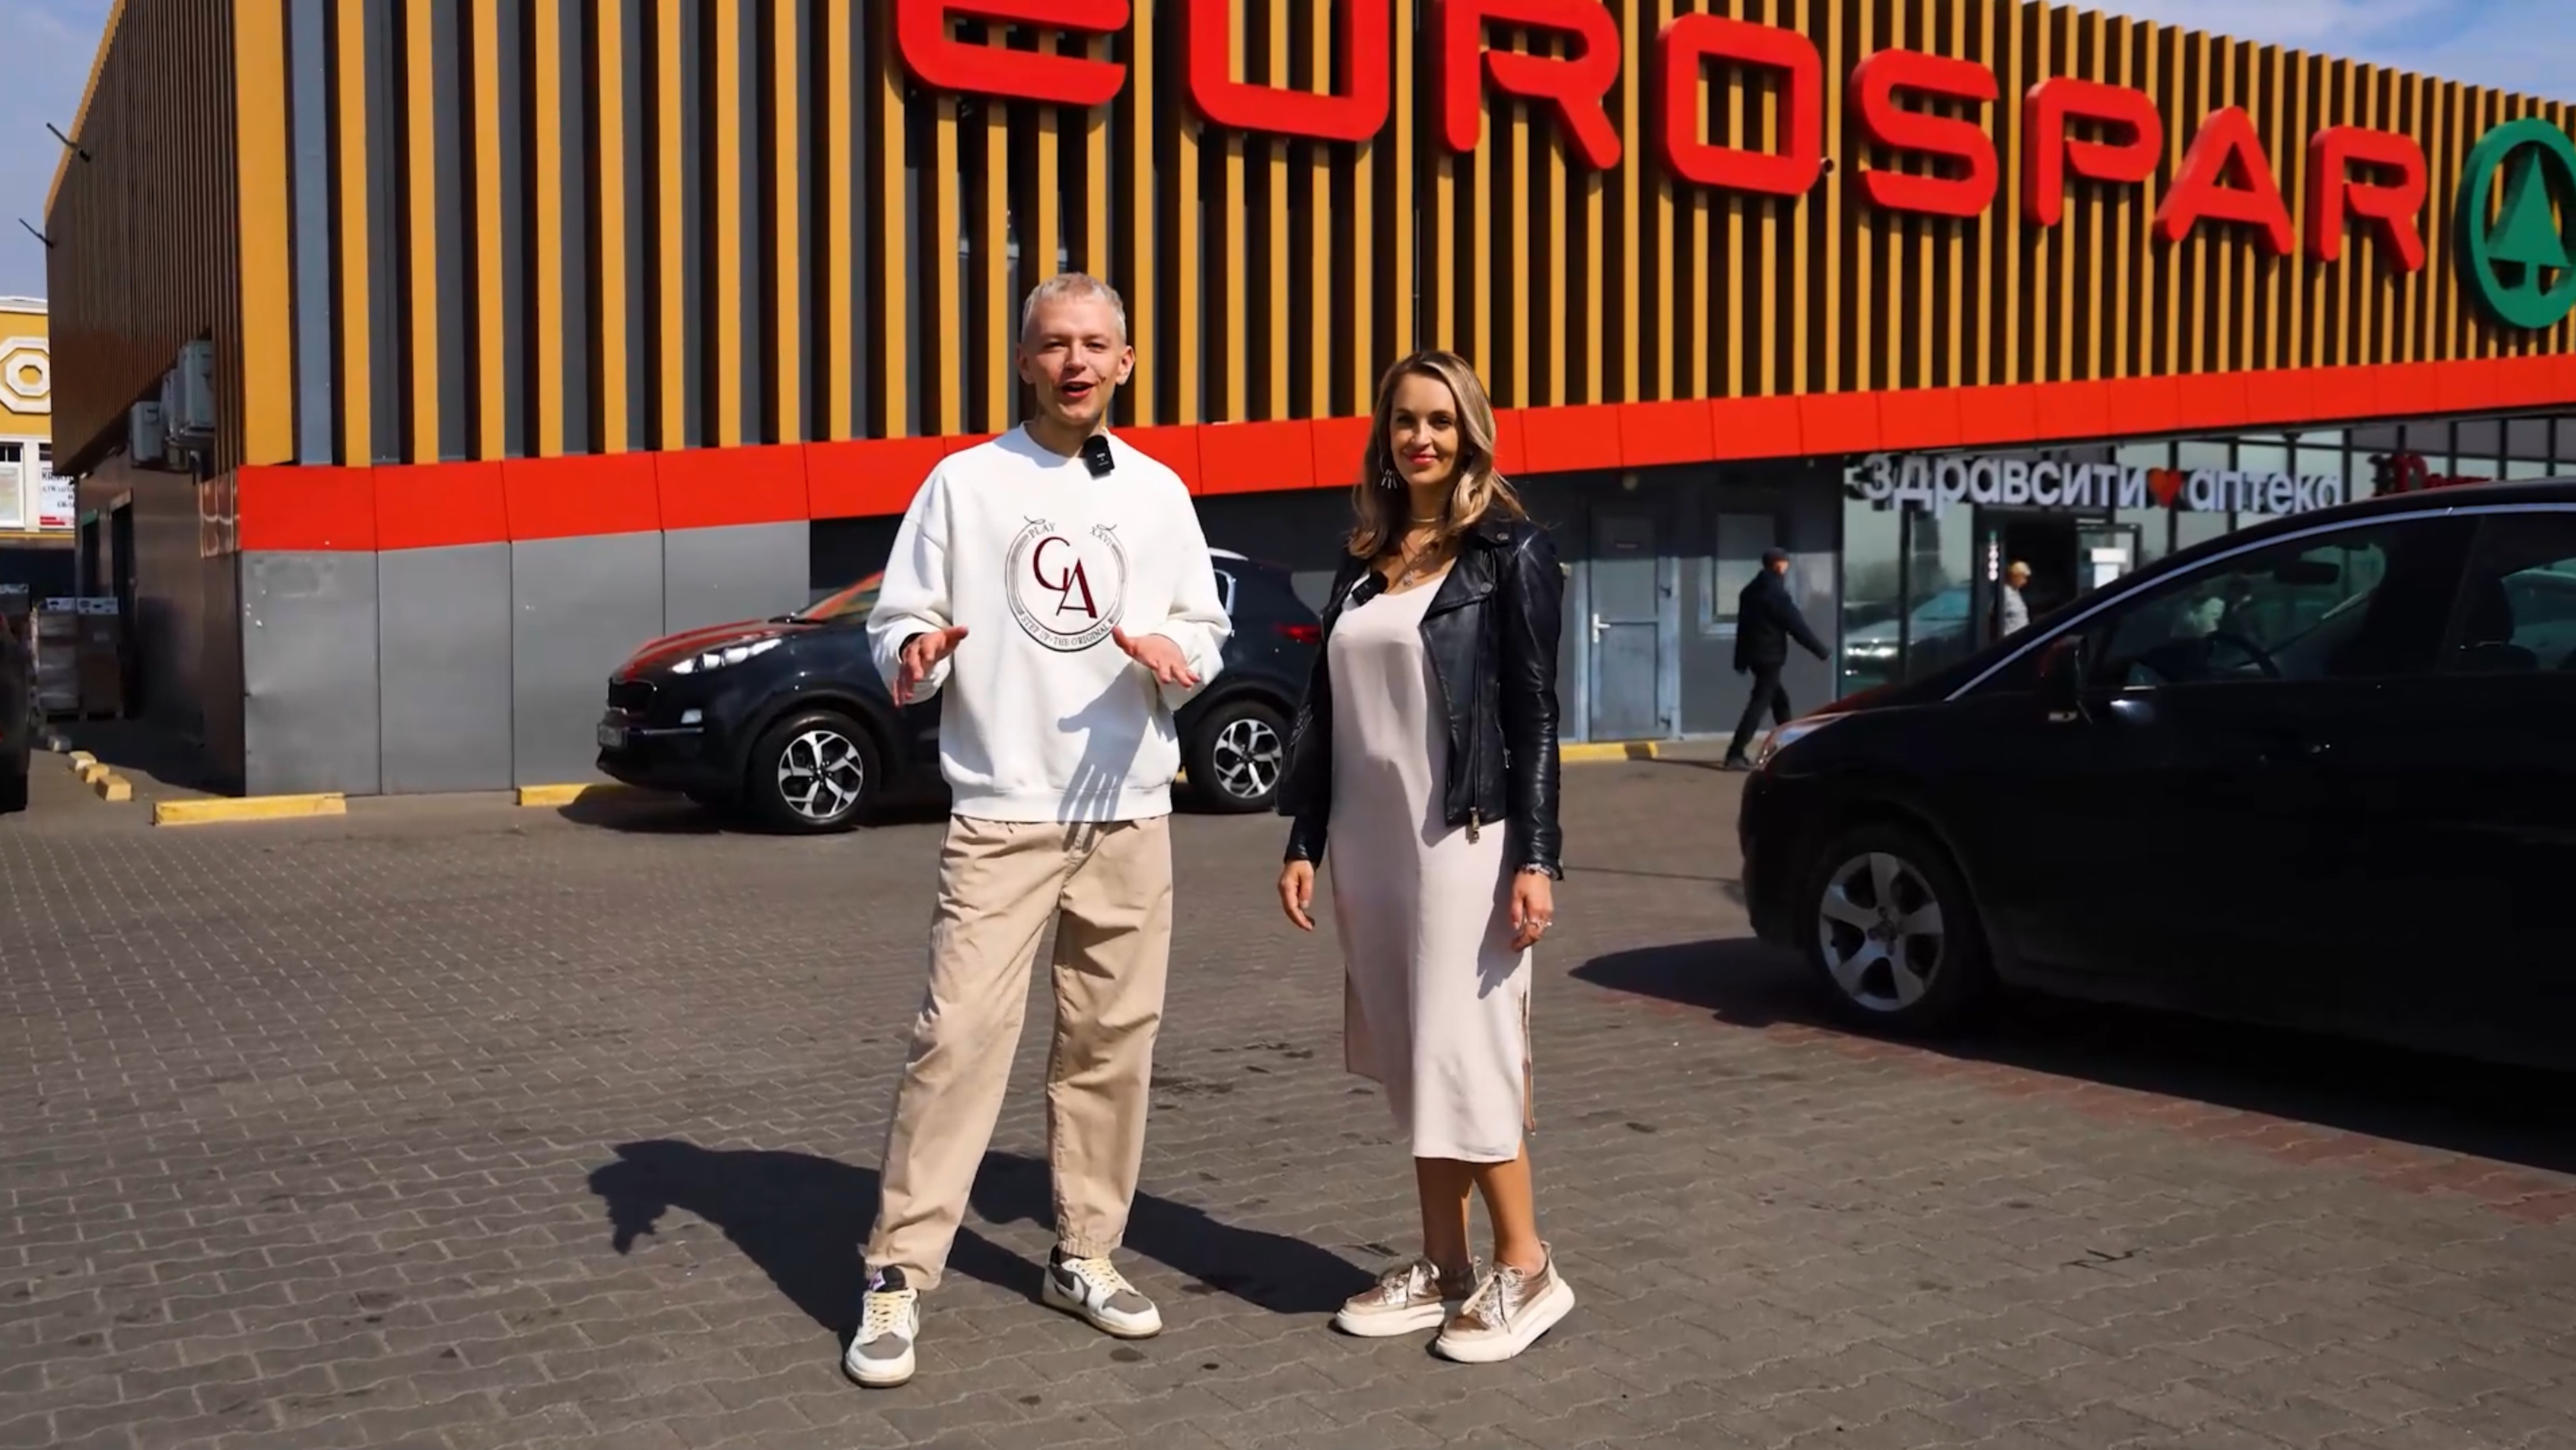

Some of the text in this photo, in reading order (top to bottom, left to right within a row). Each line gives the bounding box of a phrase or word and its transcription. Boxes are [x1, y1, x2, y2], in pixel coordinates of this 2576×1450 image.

[898, 0, 2427, 272] EUROSPAR
[2187, 468, 2343, 515] аптека
[1028, 522, 1056, 538] PLAY
[1021, 615, 1039, 633] STEP
[1053, 637, 1069, 646] THE
[1071, 624, 1111, 645] ORIGINAL
